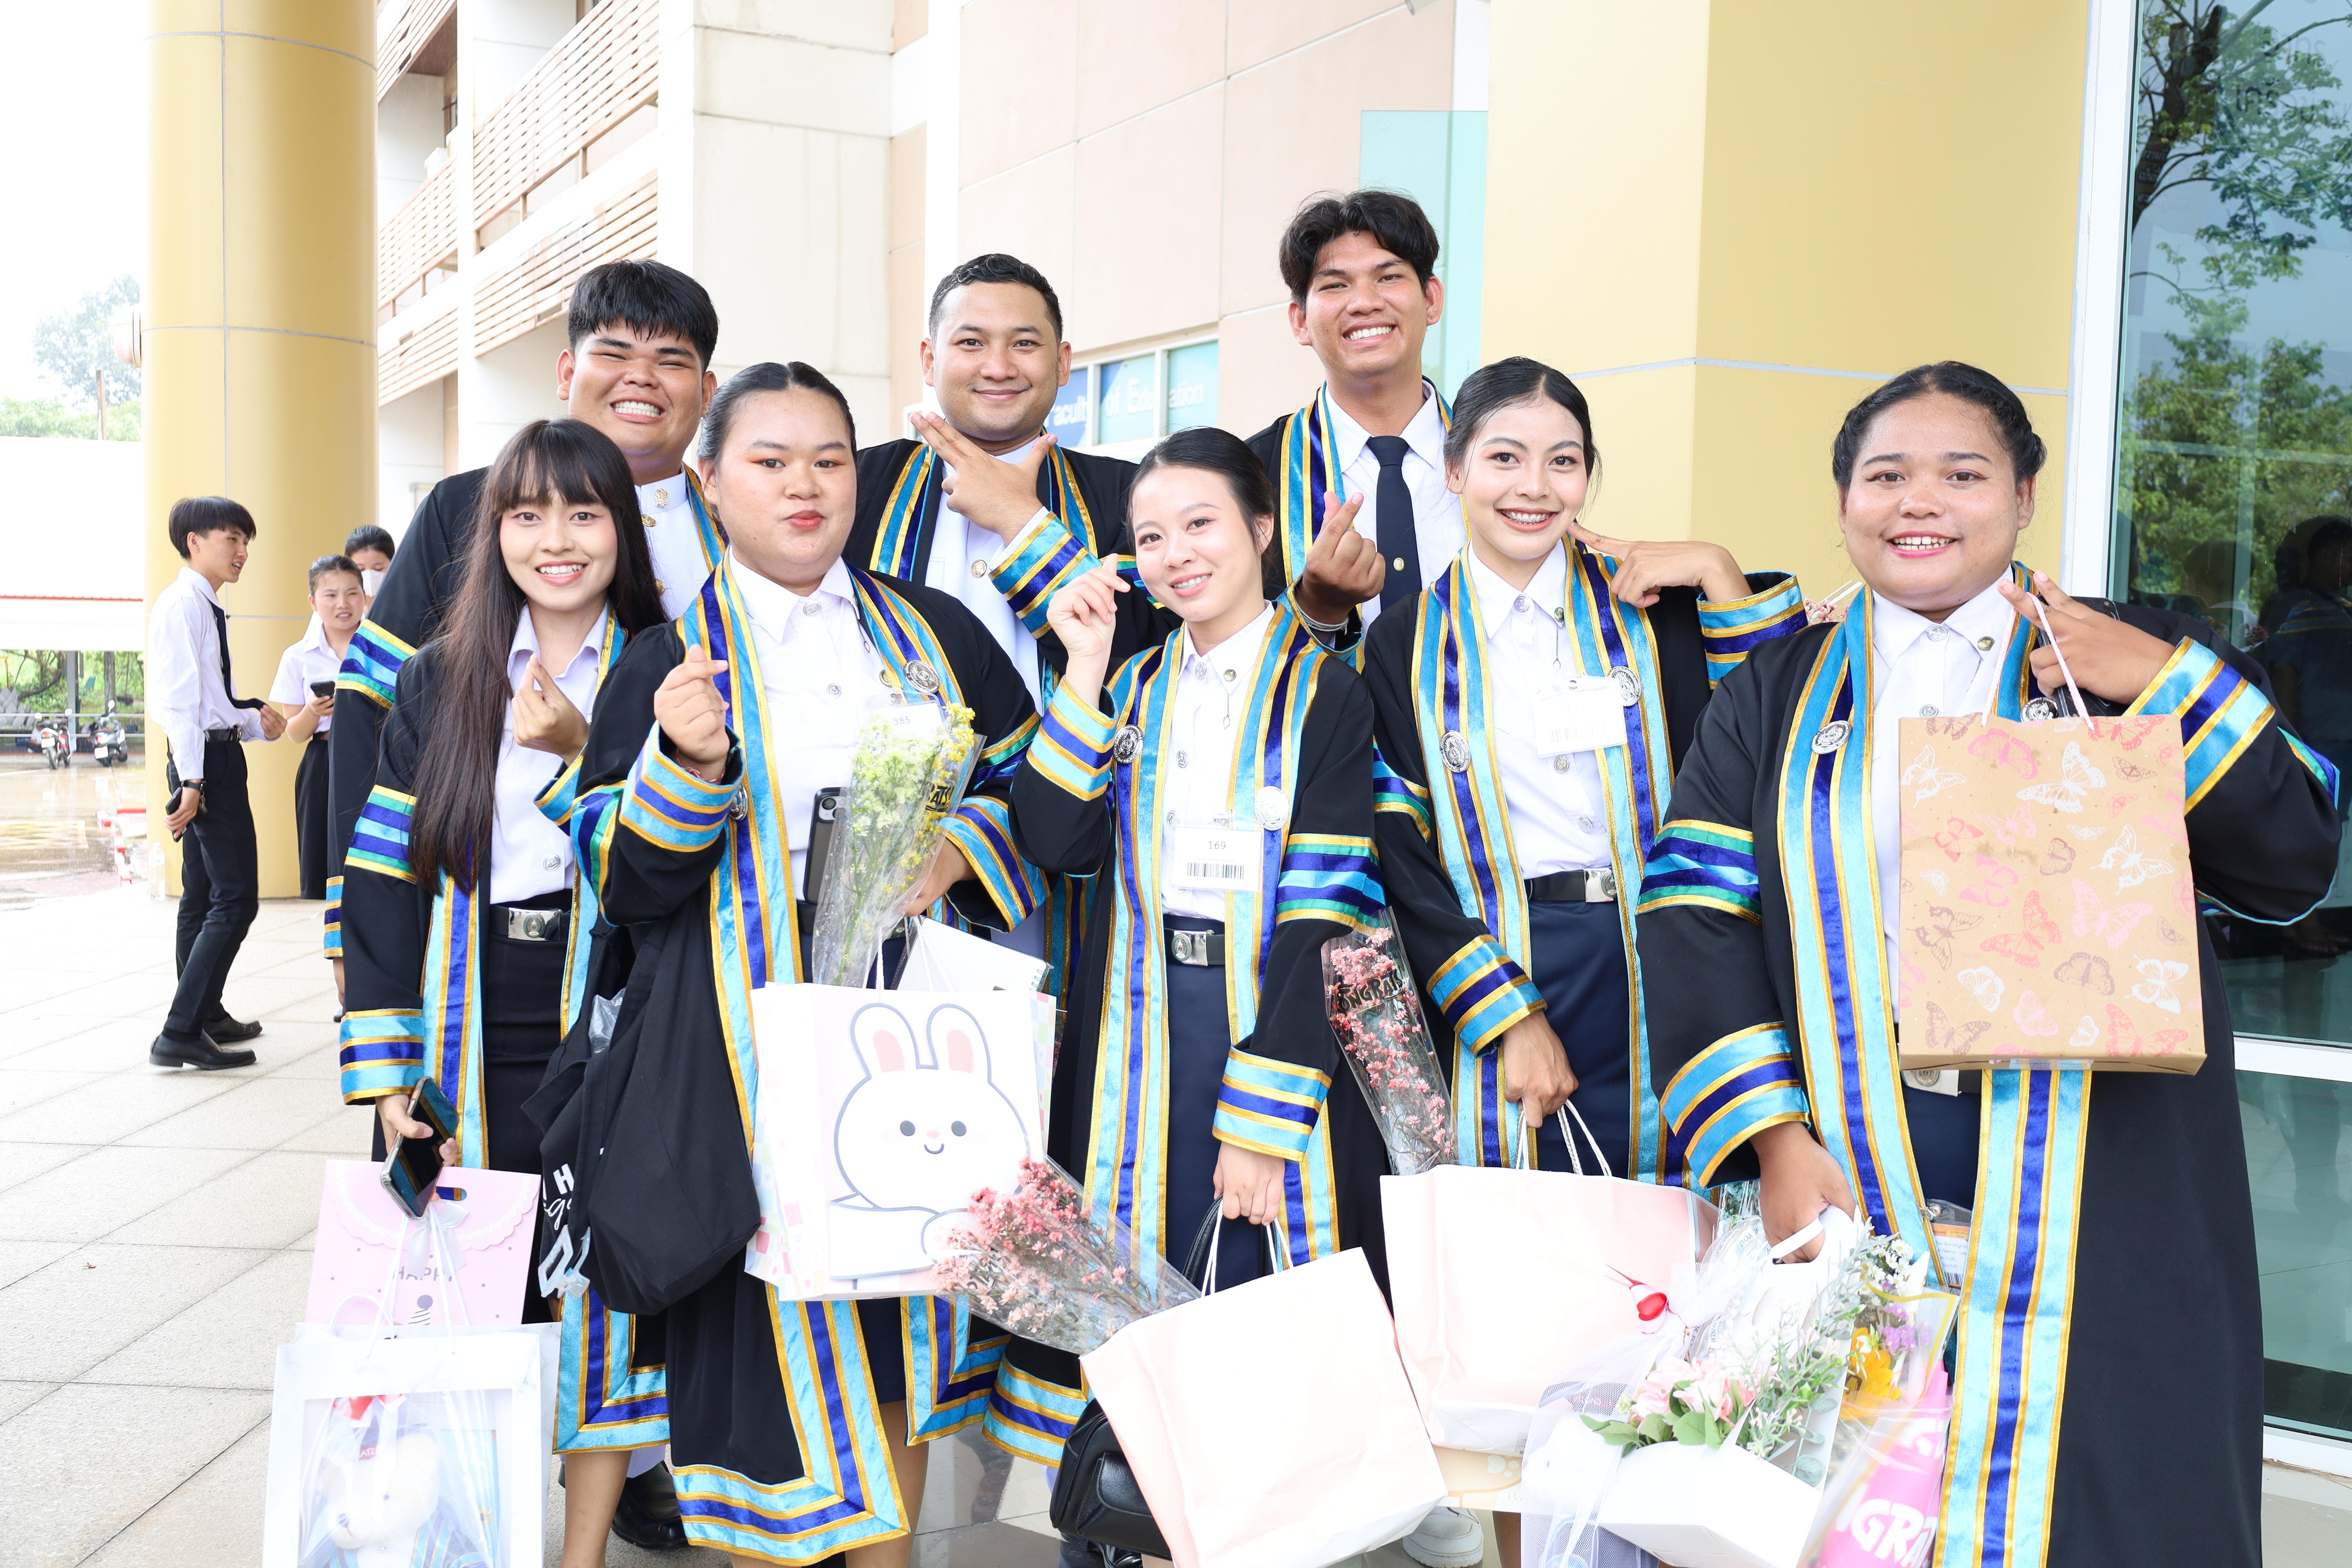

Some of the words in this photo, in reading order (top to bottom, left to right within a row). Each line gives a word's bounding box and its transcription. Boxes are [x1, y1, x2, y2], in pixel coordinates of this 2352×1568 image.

[1105, 384, 1121, 416] of
[1127, 377, 1204, 413] Eduation
[893, 716, 911, 726] 385
[1209, 841, 1226, 850] 169
